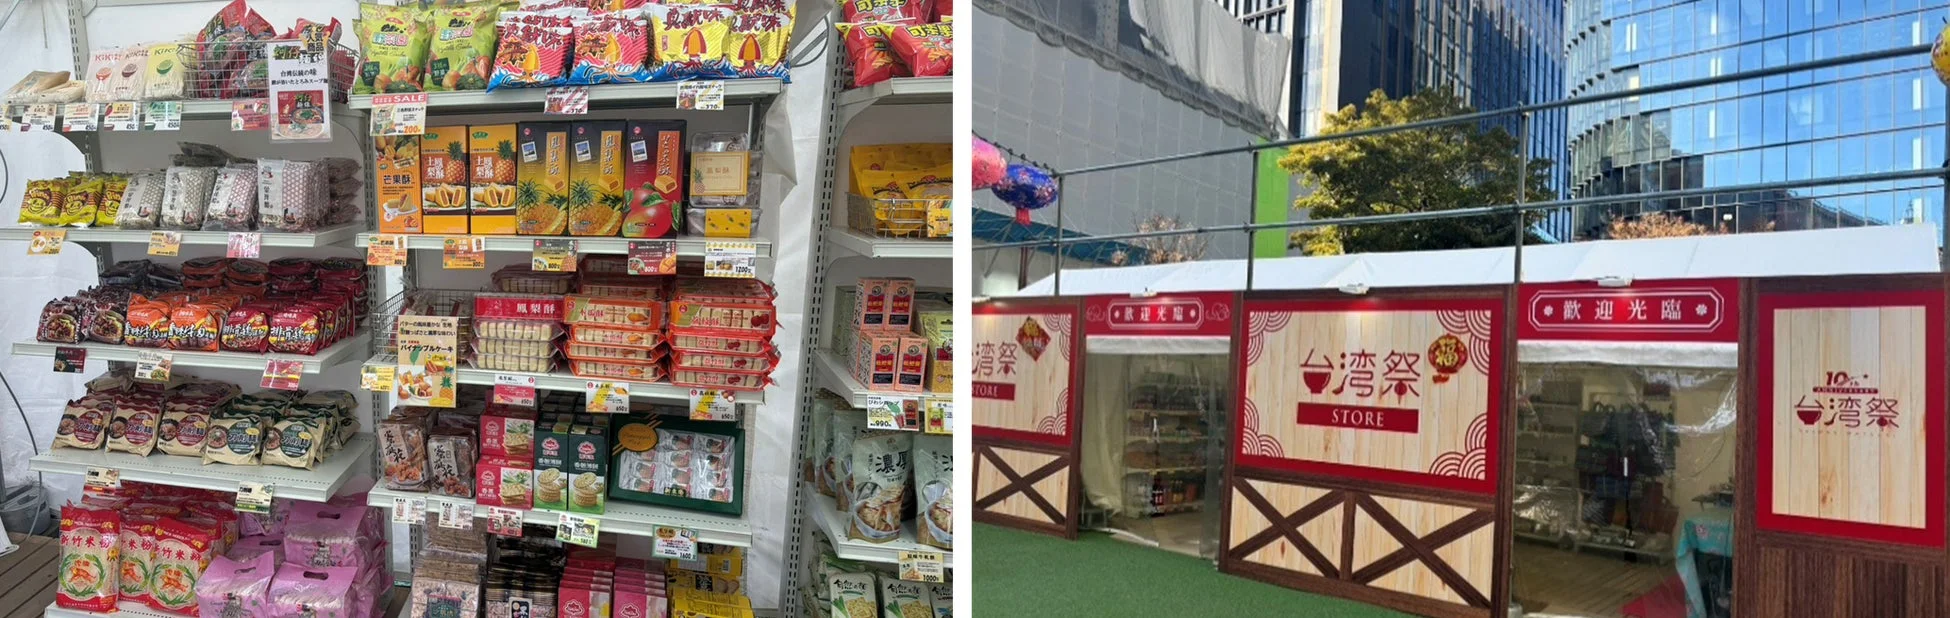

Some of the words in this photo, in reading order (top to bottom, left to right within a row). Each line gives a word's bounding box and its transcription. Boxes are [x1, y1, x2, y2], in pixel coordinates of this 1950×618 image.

[280, 68, 317, 77] 台湾伝統の味
[393, 94, 425, 103] SALE
[516, 303, 556, 315] 鳳梨酥
[1123, 306, 1184, 322] 歡迎光臨
[1563, 298, 1682, 321] 歡迎光臨
[1300, 348, 1421, 405] 台湾祭
[1331, 409, 1385, 428] STORE
[1794, 395, 1899, 432] 台湾祭
[875, 450, 908, 474] 濃厚
